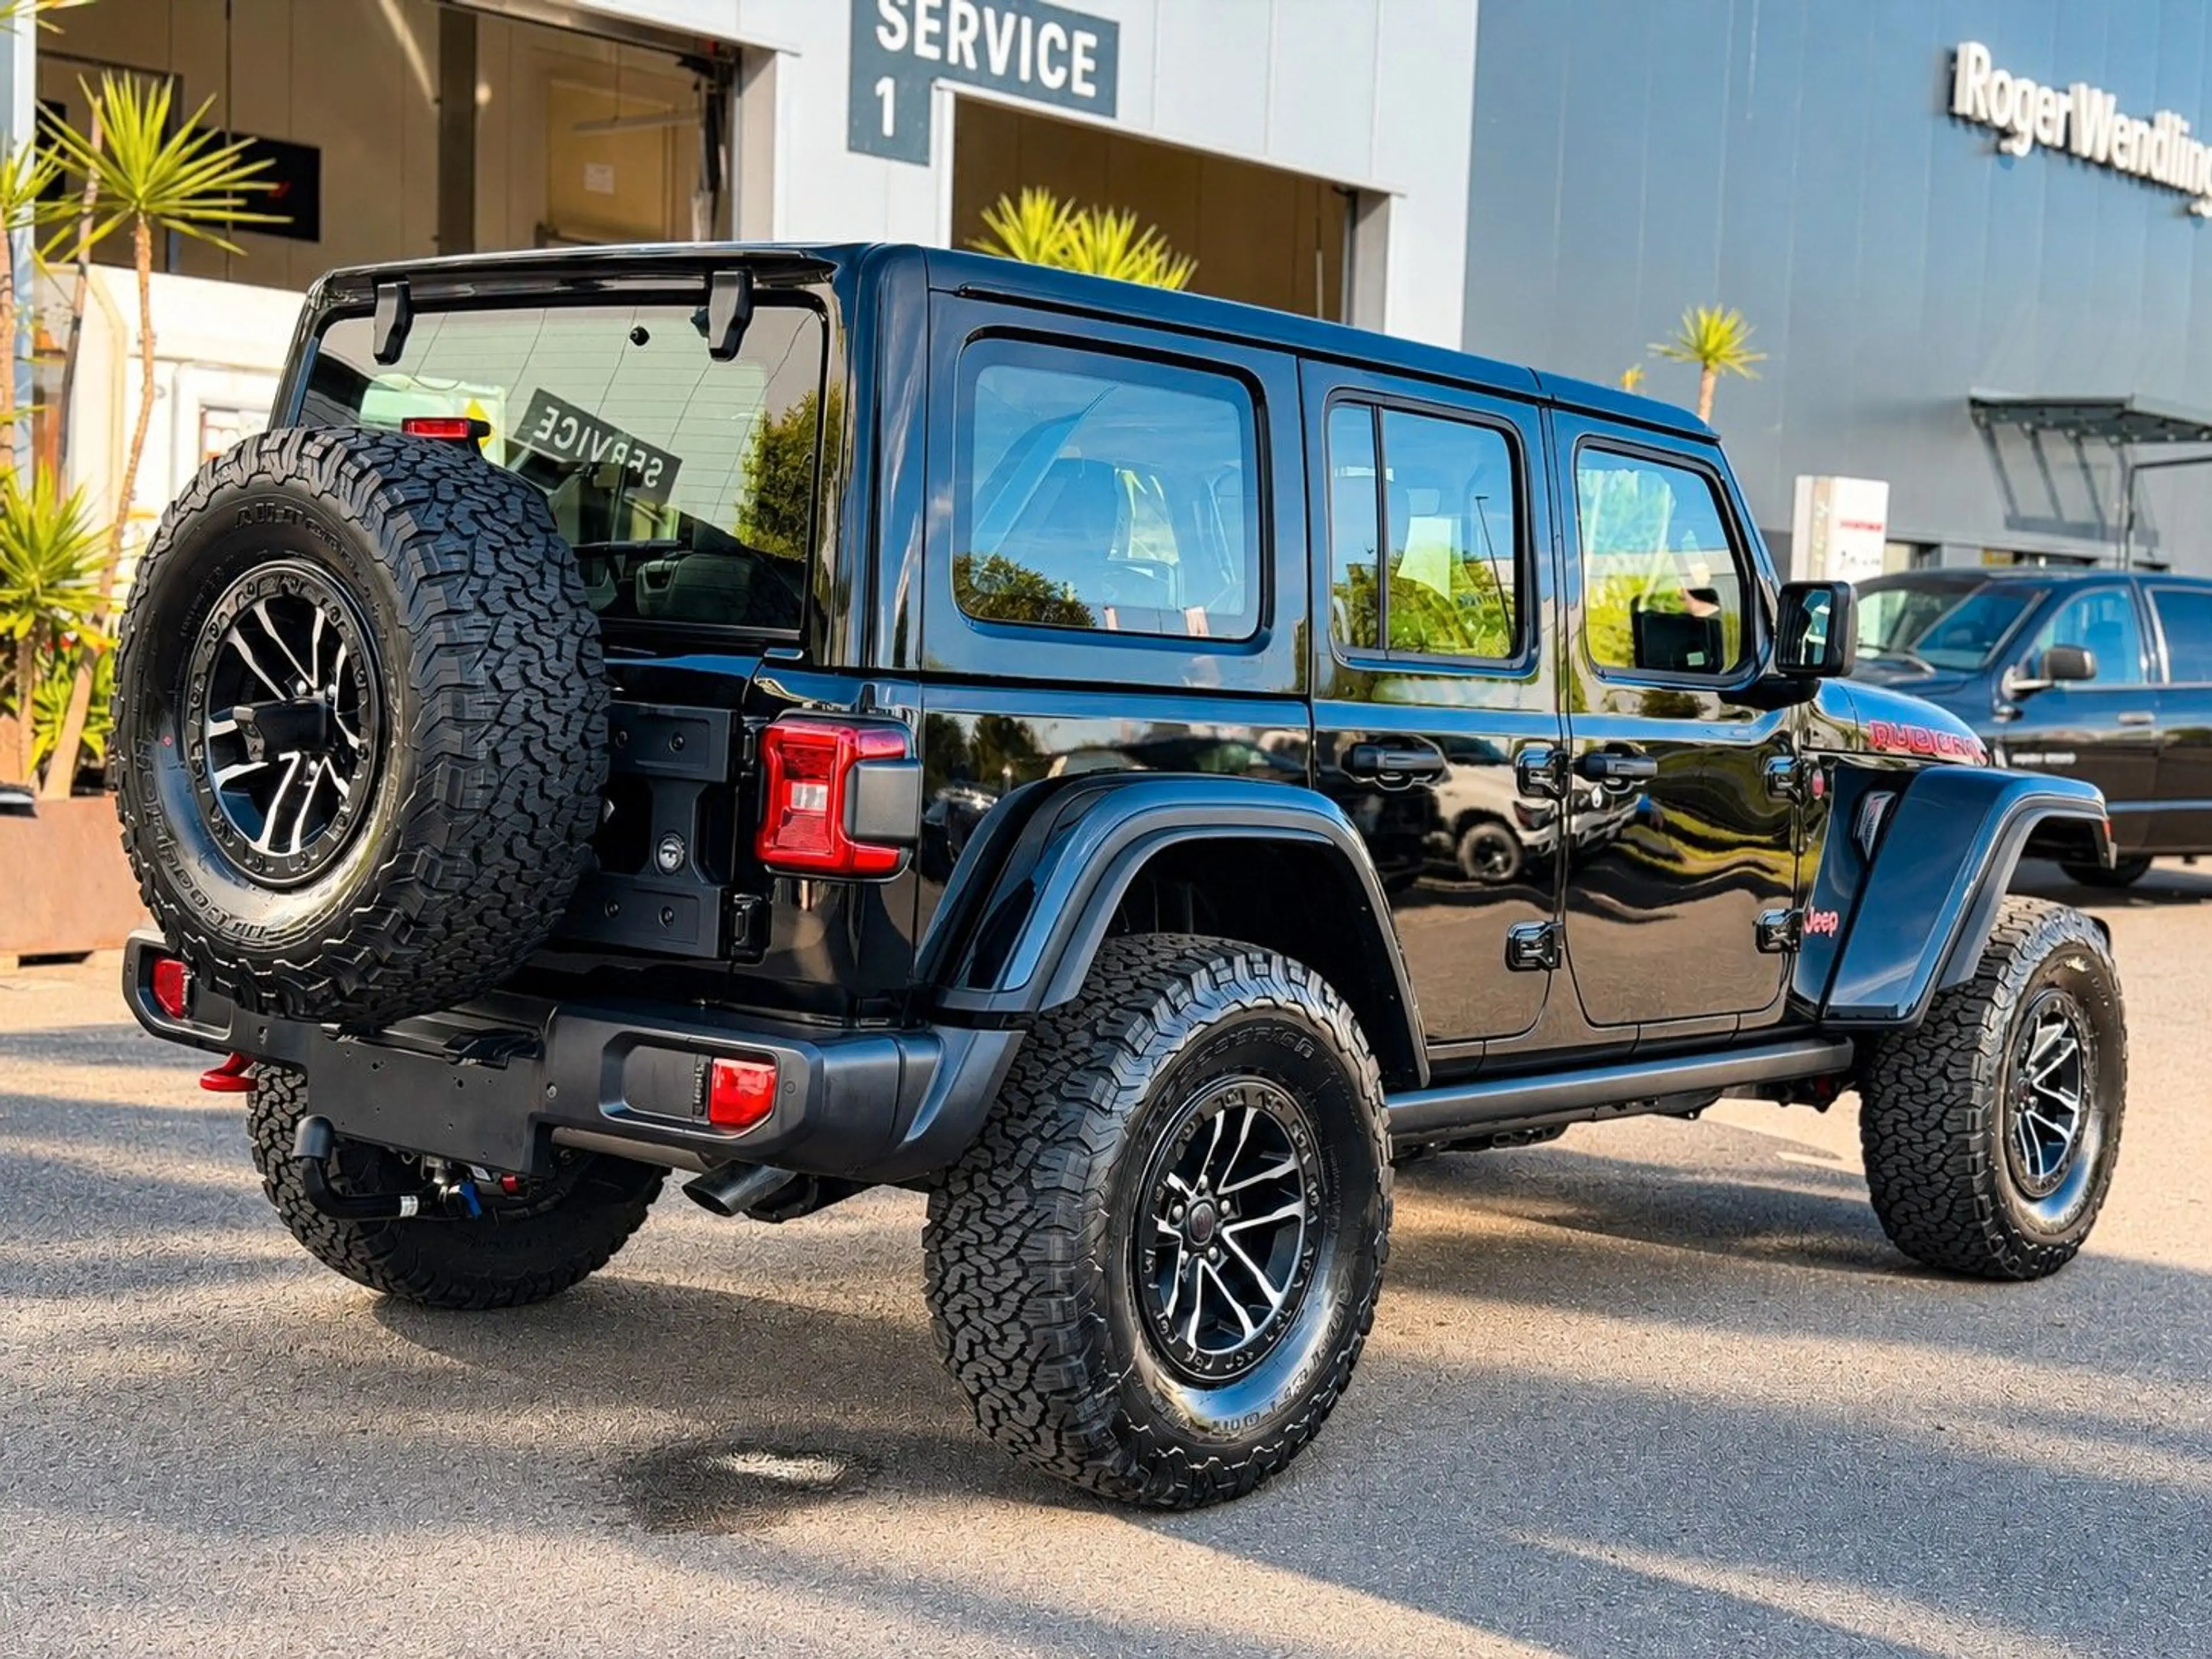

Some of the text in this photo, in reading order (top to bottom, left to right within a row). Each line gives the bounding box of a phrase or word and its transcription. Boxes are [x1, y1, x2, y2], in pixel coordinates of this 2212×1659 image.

[875, 0, 1098, 98] SERVICE
[875, 76, 895, 138] 1
[1954, 41, 2074, 157] Roger
[1804, 906, 1839, 938] Jeep
